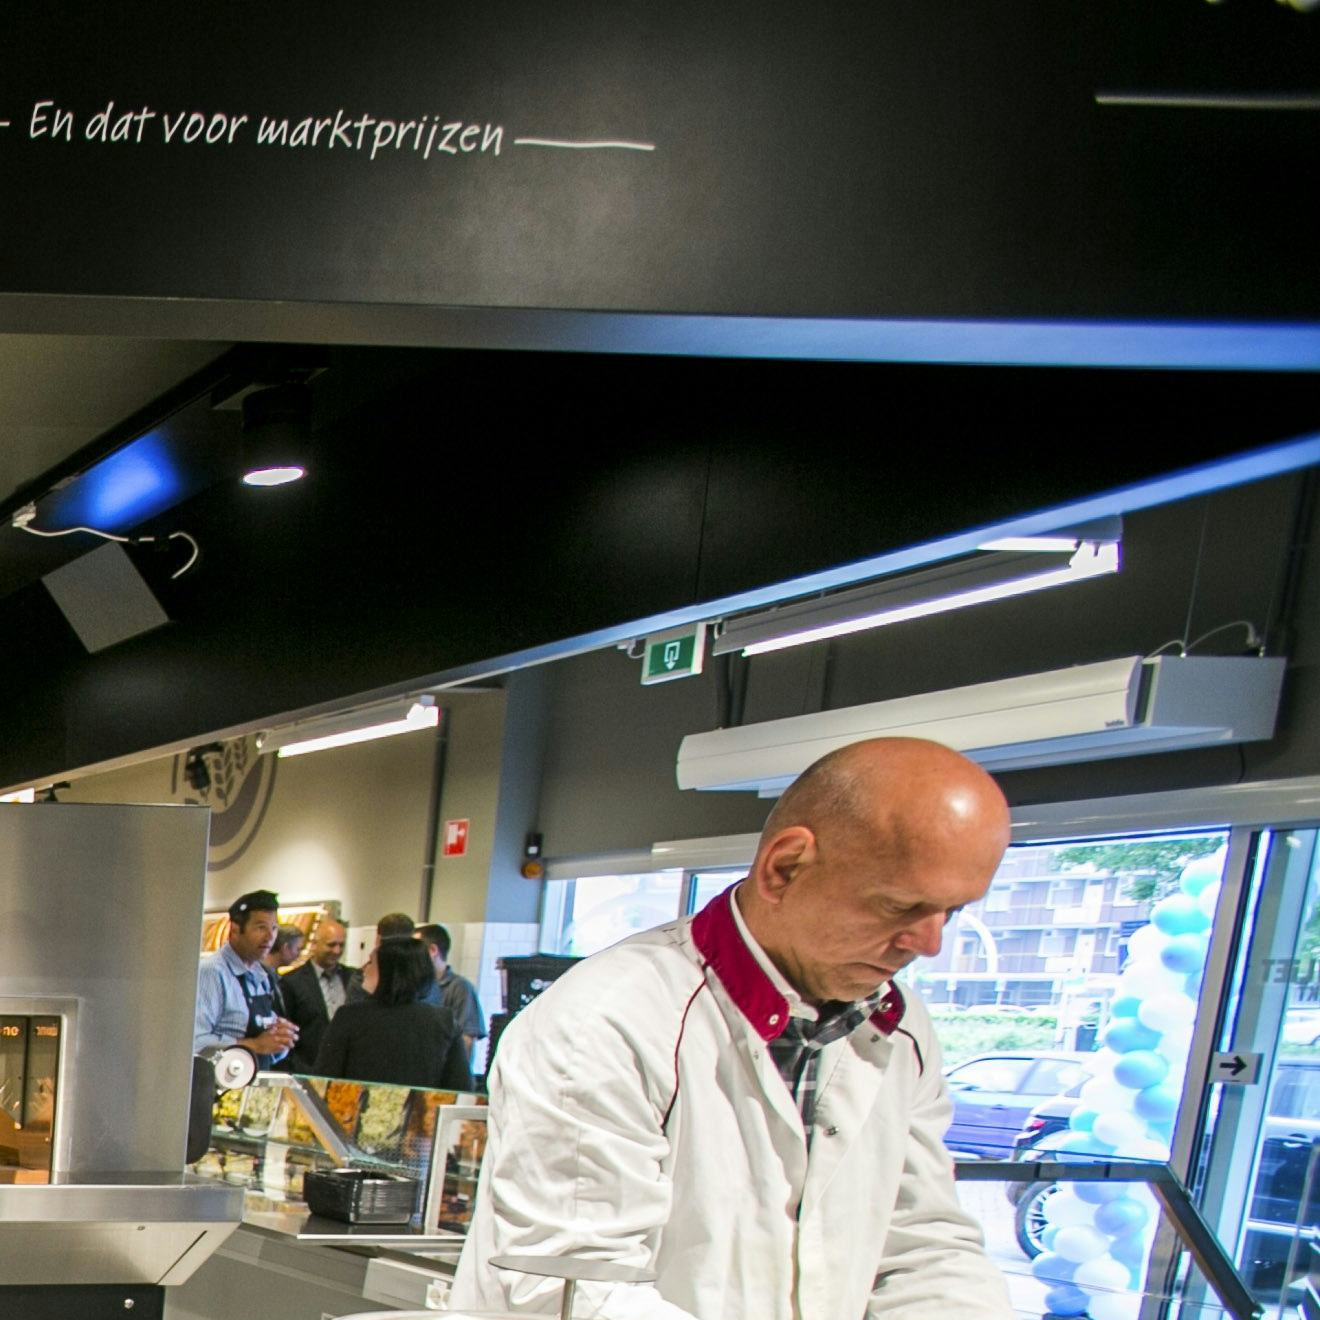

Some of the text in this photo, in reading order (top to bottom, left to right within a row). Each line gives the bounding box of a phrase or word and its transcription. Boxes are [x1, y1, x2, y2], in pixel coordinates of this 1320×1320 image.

[29, 99, 504, 161] En dat voor marktprijzen
